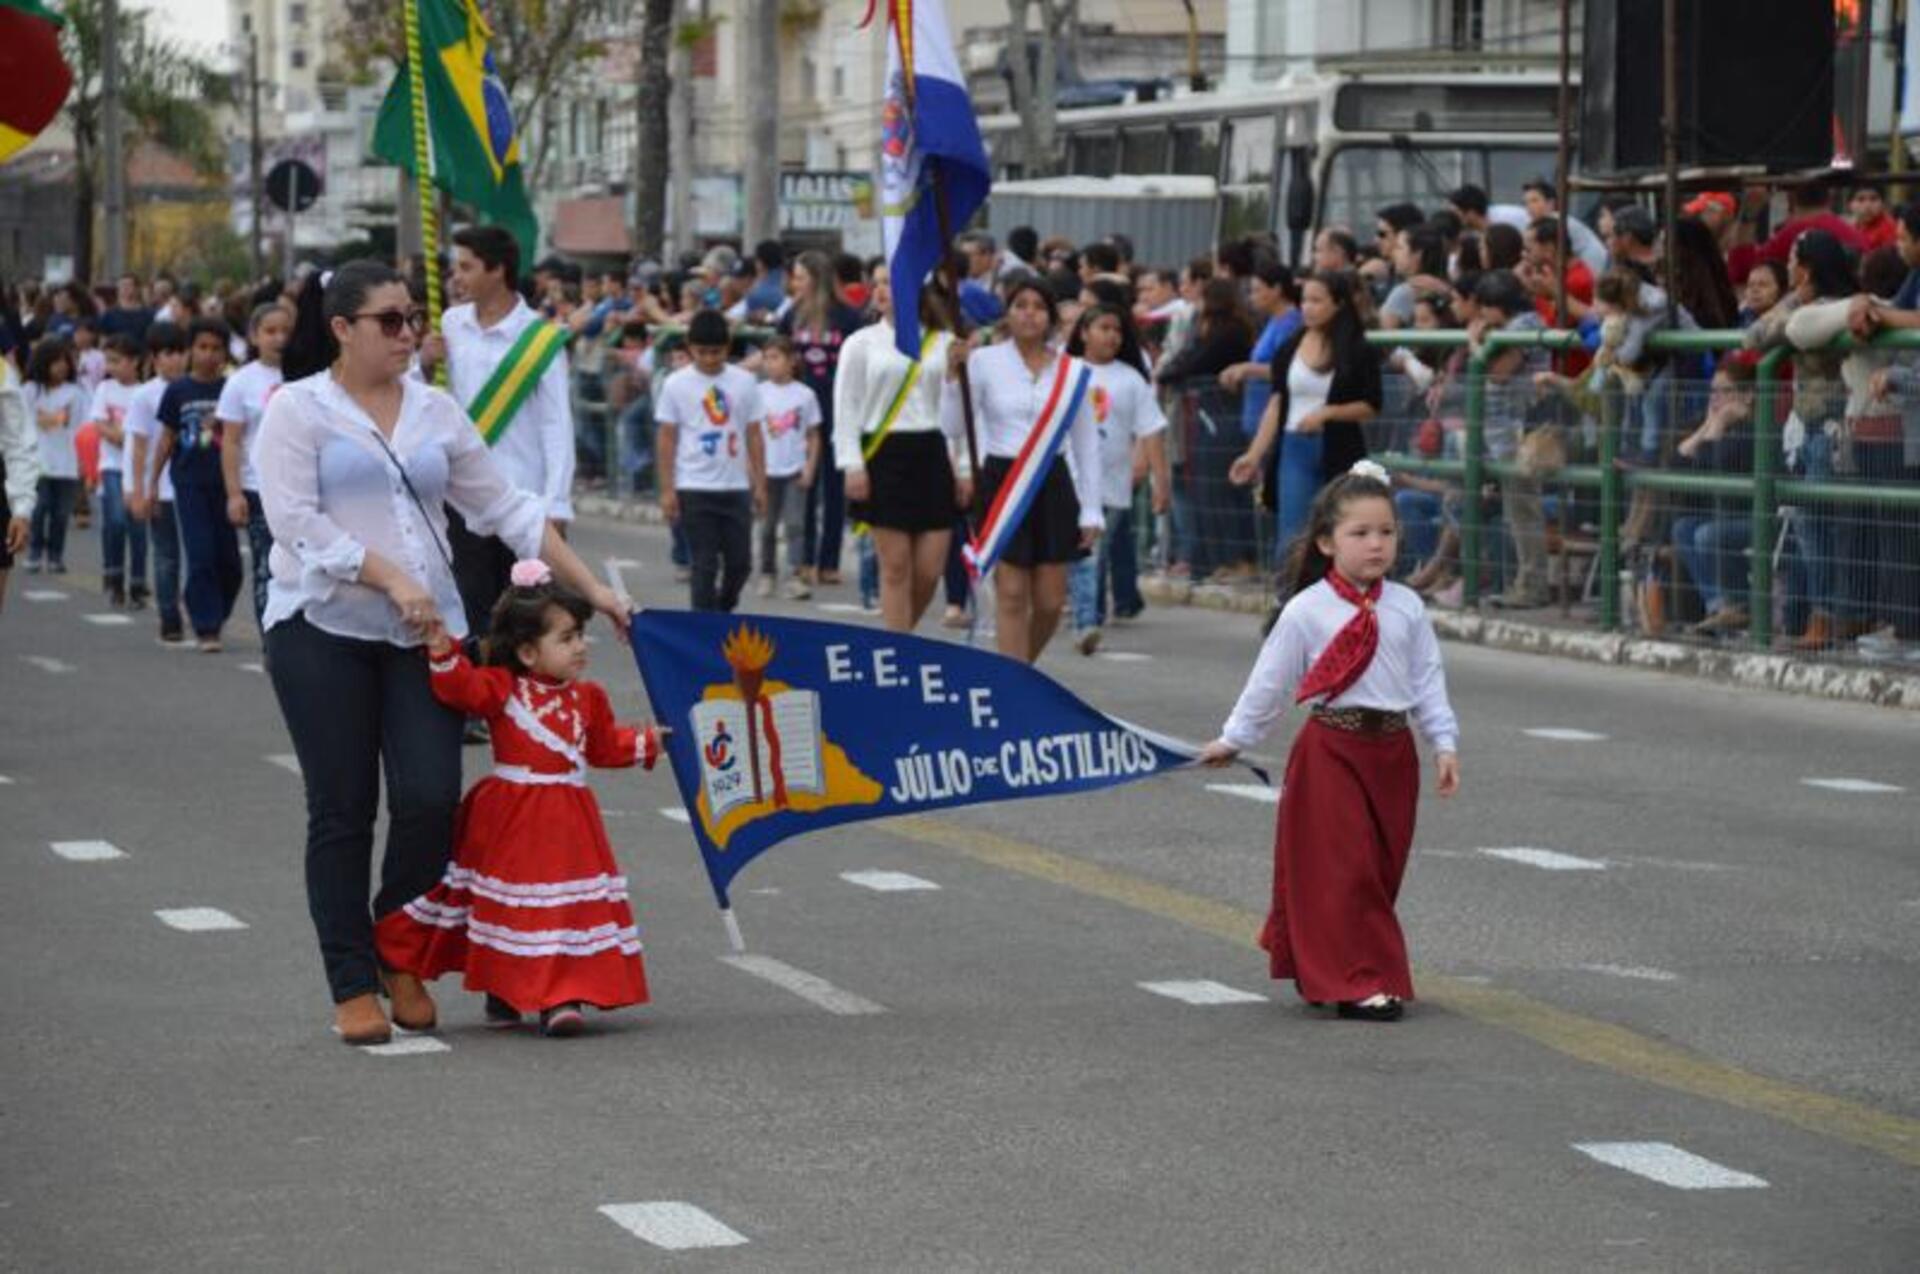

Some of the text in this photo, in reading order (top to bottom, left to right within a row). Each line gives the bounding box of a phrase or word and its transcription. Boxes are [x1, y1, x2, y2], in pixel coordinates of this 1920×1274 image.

[825, 644, 999, 728] E. E. E. F.
[891, 730, 1158, 803] JÚLIO DE CASTILHOS
